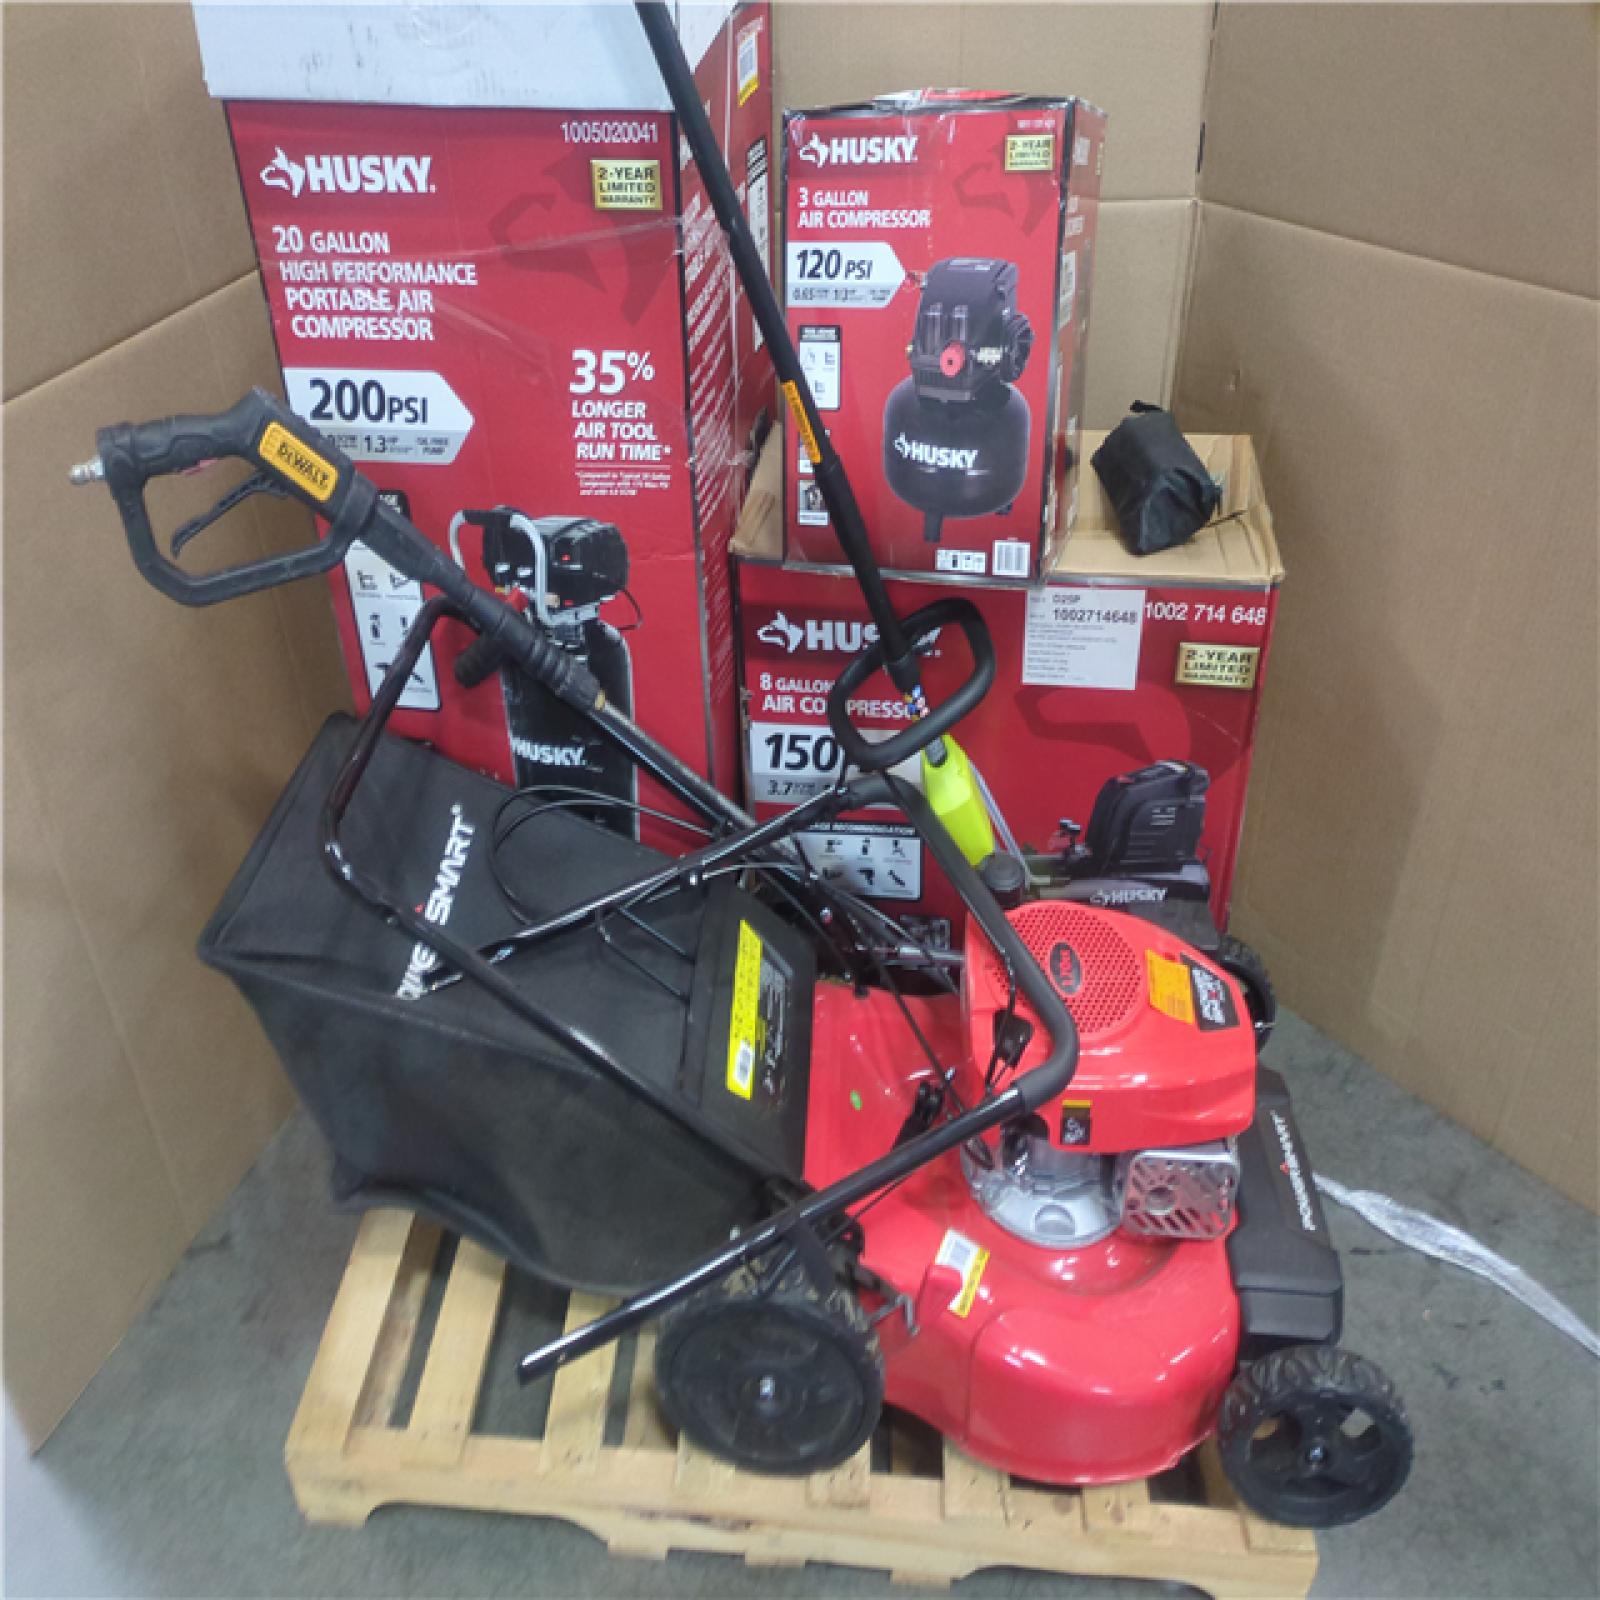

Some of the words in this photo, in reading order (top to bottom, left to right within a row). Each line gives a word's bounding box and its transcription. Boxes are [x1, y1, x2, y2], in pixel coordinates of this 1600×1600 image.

[560, 121, 659, 144] 1005020041
[599, 182, 656, 193] LIMITED
[798, 187, 809, 208] 3
[812, 190, 869, 208] GALLON
[798, 209, 827, 229] AIR
[827, 210, 931, 229] COMPRESSOR
[273, 226, 304, 254] 20
[310, 231, 390, 254] GALLON
[279, 260, 328, 284] HIGH
[332, 263, 478, 286] PERFORMANCE
[797, 249, 841, 280] 120
[845, 260, 873, 280] PSI
[285, 287, 392, 312] PORTABLE
[400, 290, 434, 313] AIR
[291, 315, 435, 341] COMPRESSOR
[571, 401, 646, 419] LONGER
[574, 421, 609, 440] AIR
[612, 423, 658, 442] TOOL
[576, 443, 614, 461] RUN
[1053, 608, 1138, 625] 1002714648
[1144, 602, 1188, 621] 1002
[1194, 604, 1226, 623] 714
[1231, 605, 1267, 626] 648
[759, 672, 773, 691] 8
[762, 694, 796, 713] AIR
